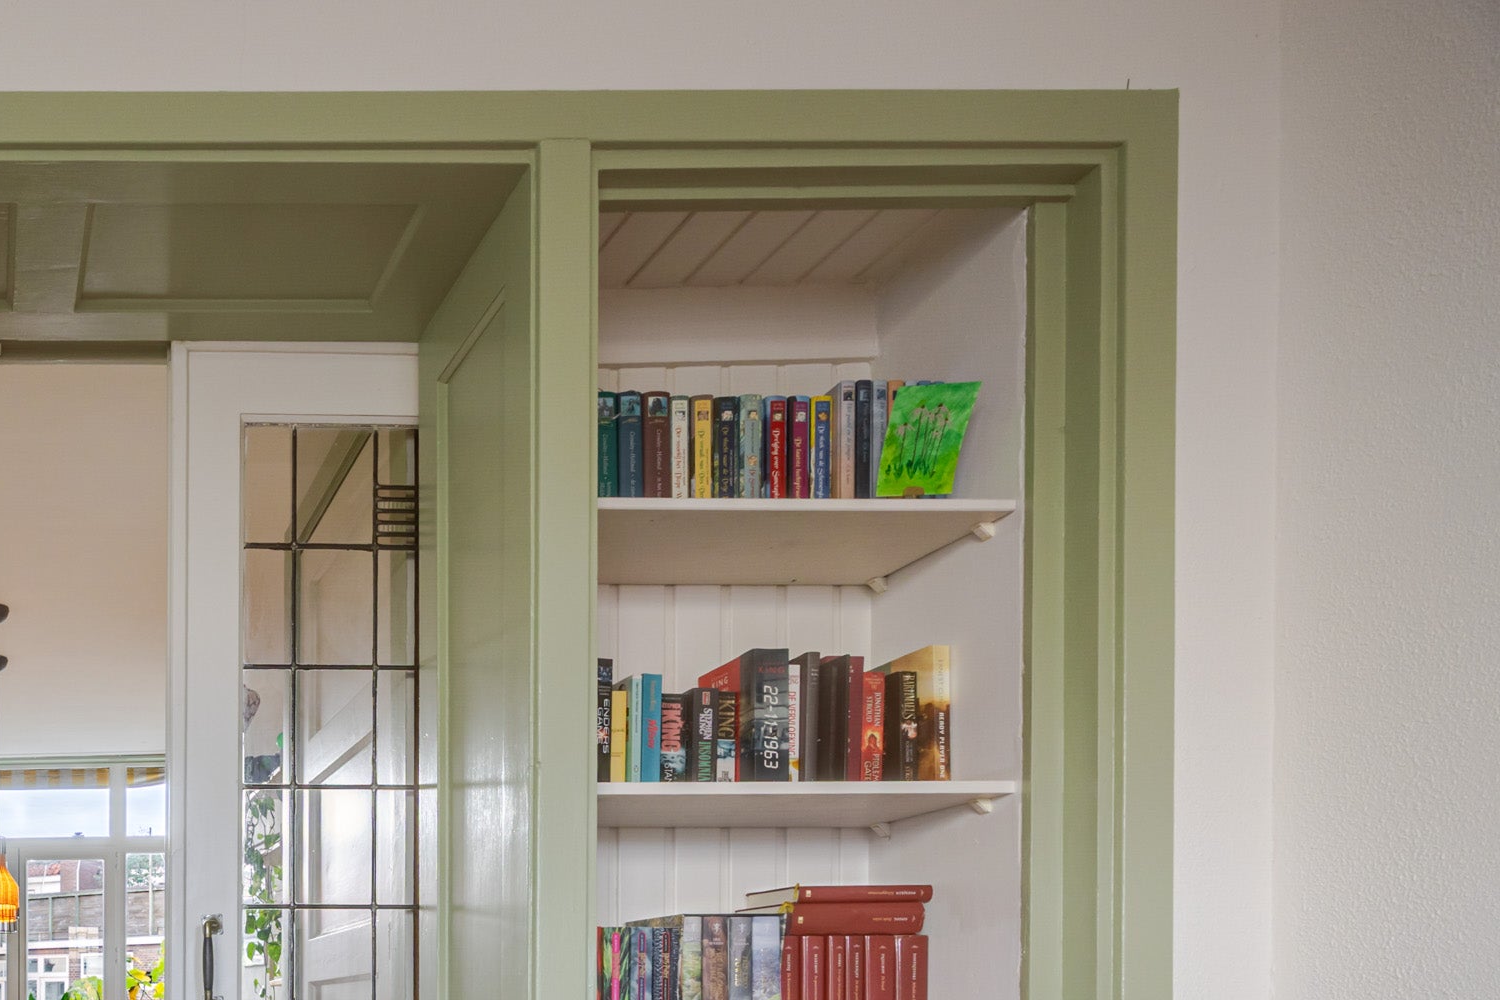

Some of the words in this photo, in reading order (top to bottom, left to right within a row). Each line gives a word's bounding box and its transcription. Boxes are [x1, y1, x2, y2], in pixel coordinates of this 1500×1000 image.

[699, 714, 707, 735] KING
[702, 708, 712, 740] STEPHEN
[718, 699, 735, 738] KING
[763, 685, 779, 769] 22-11-1963
[873, 692, 881, 727] JONATHAN
[662, 709, 683, 753] KING
[698, 741, 712, 781] INSOMNIA
